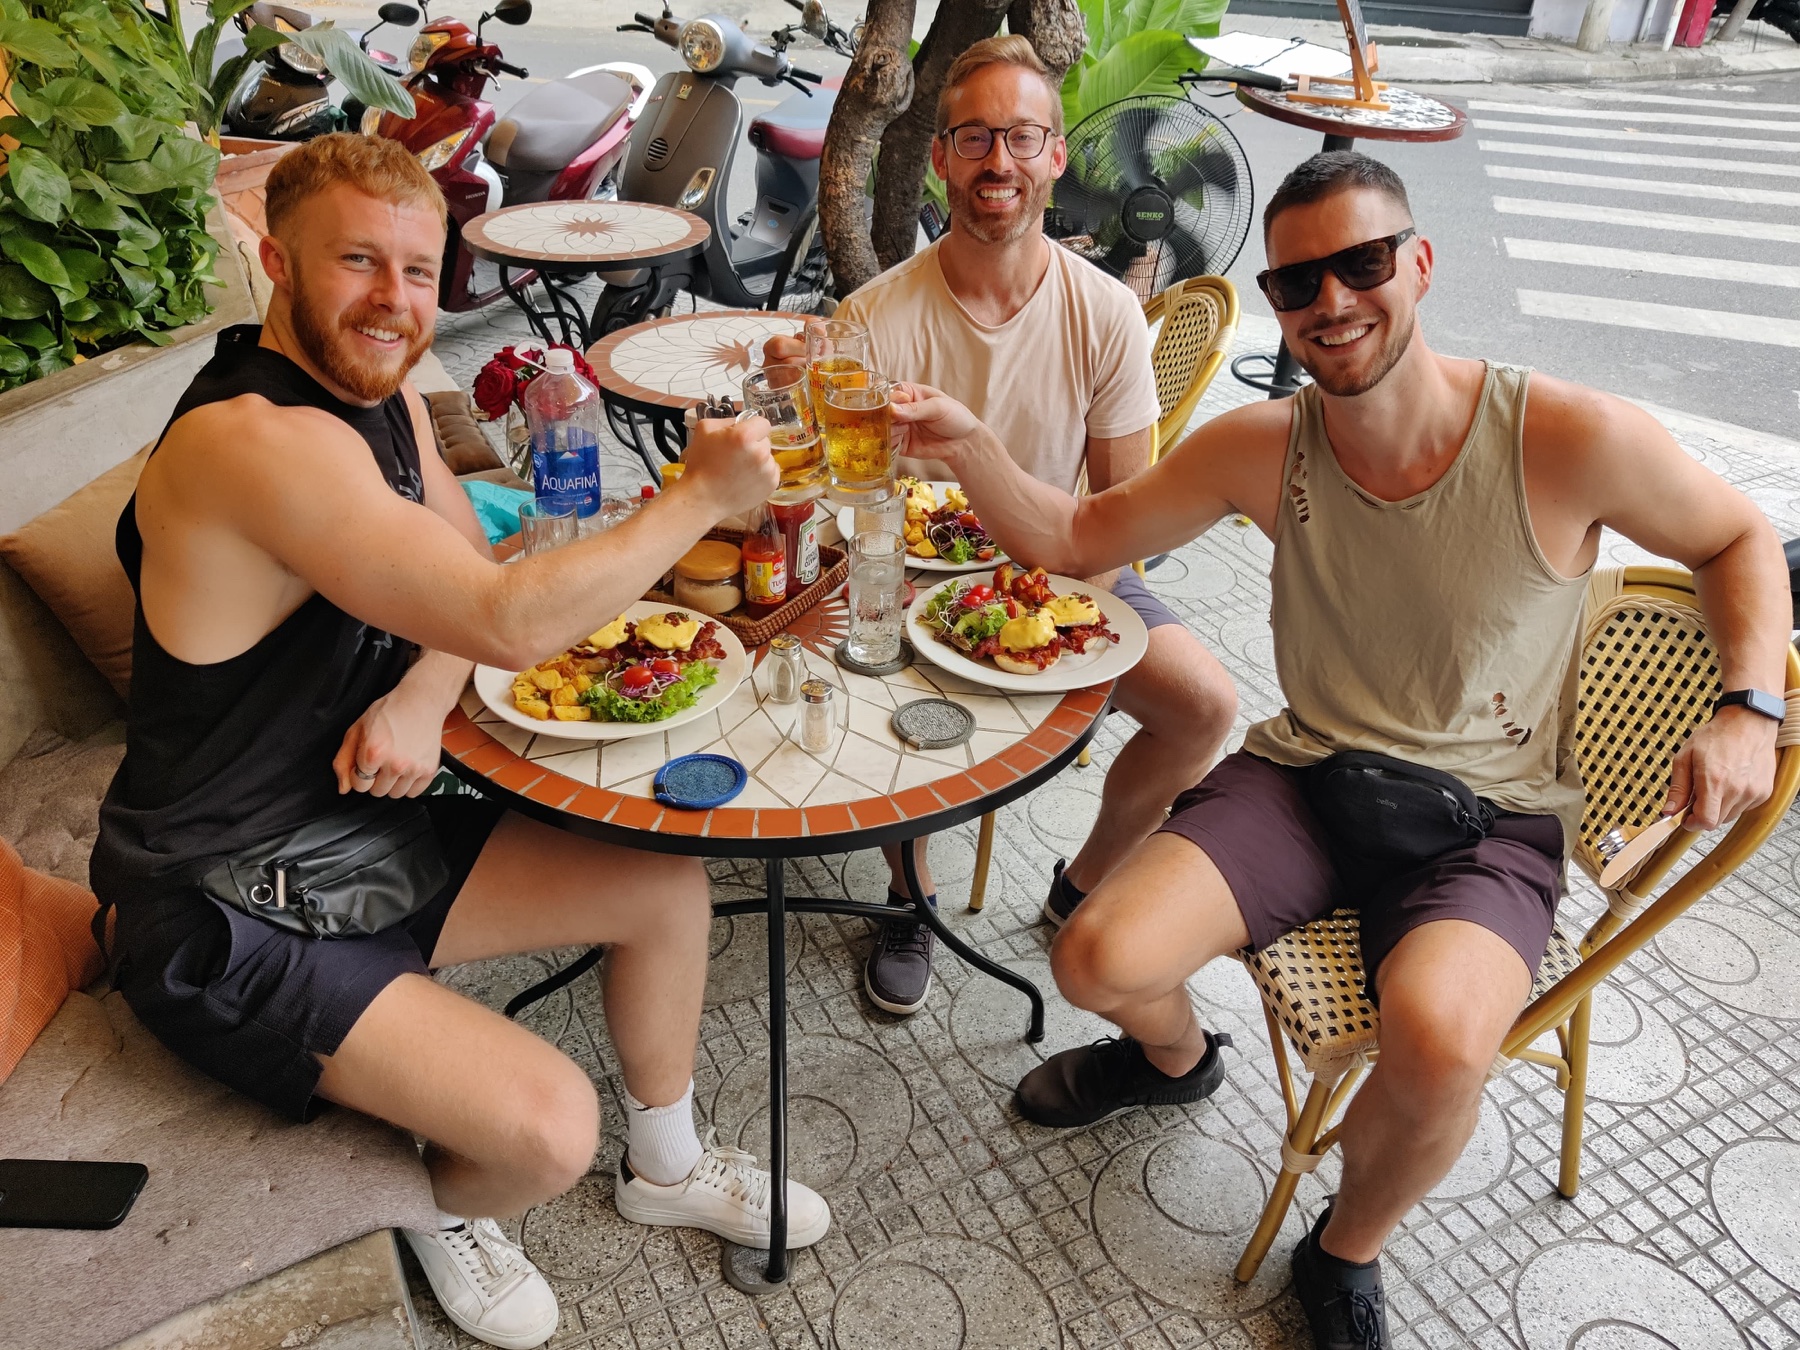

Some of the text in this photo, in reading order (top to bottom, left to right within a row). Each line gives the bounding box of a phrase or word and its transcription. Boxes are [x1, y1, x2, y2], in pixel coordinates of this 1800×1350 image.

[1135, 211, 1165, 219] SENKO
[542, 472, 598, 493] AQUAFINA
[1376, 797, 1398, 809] bellroy
